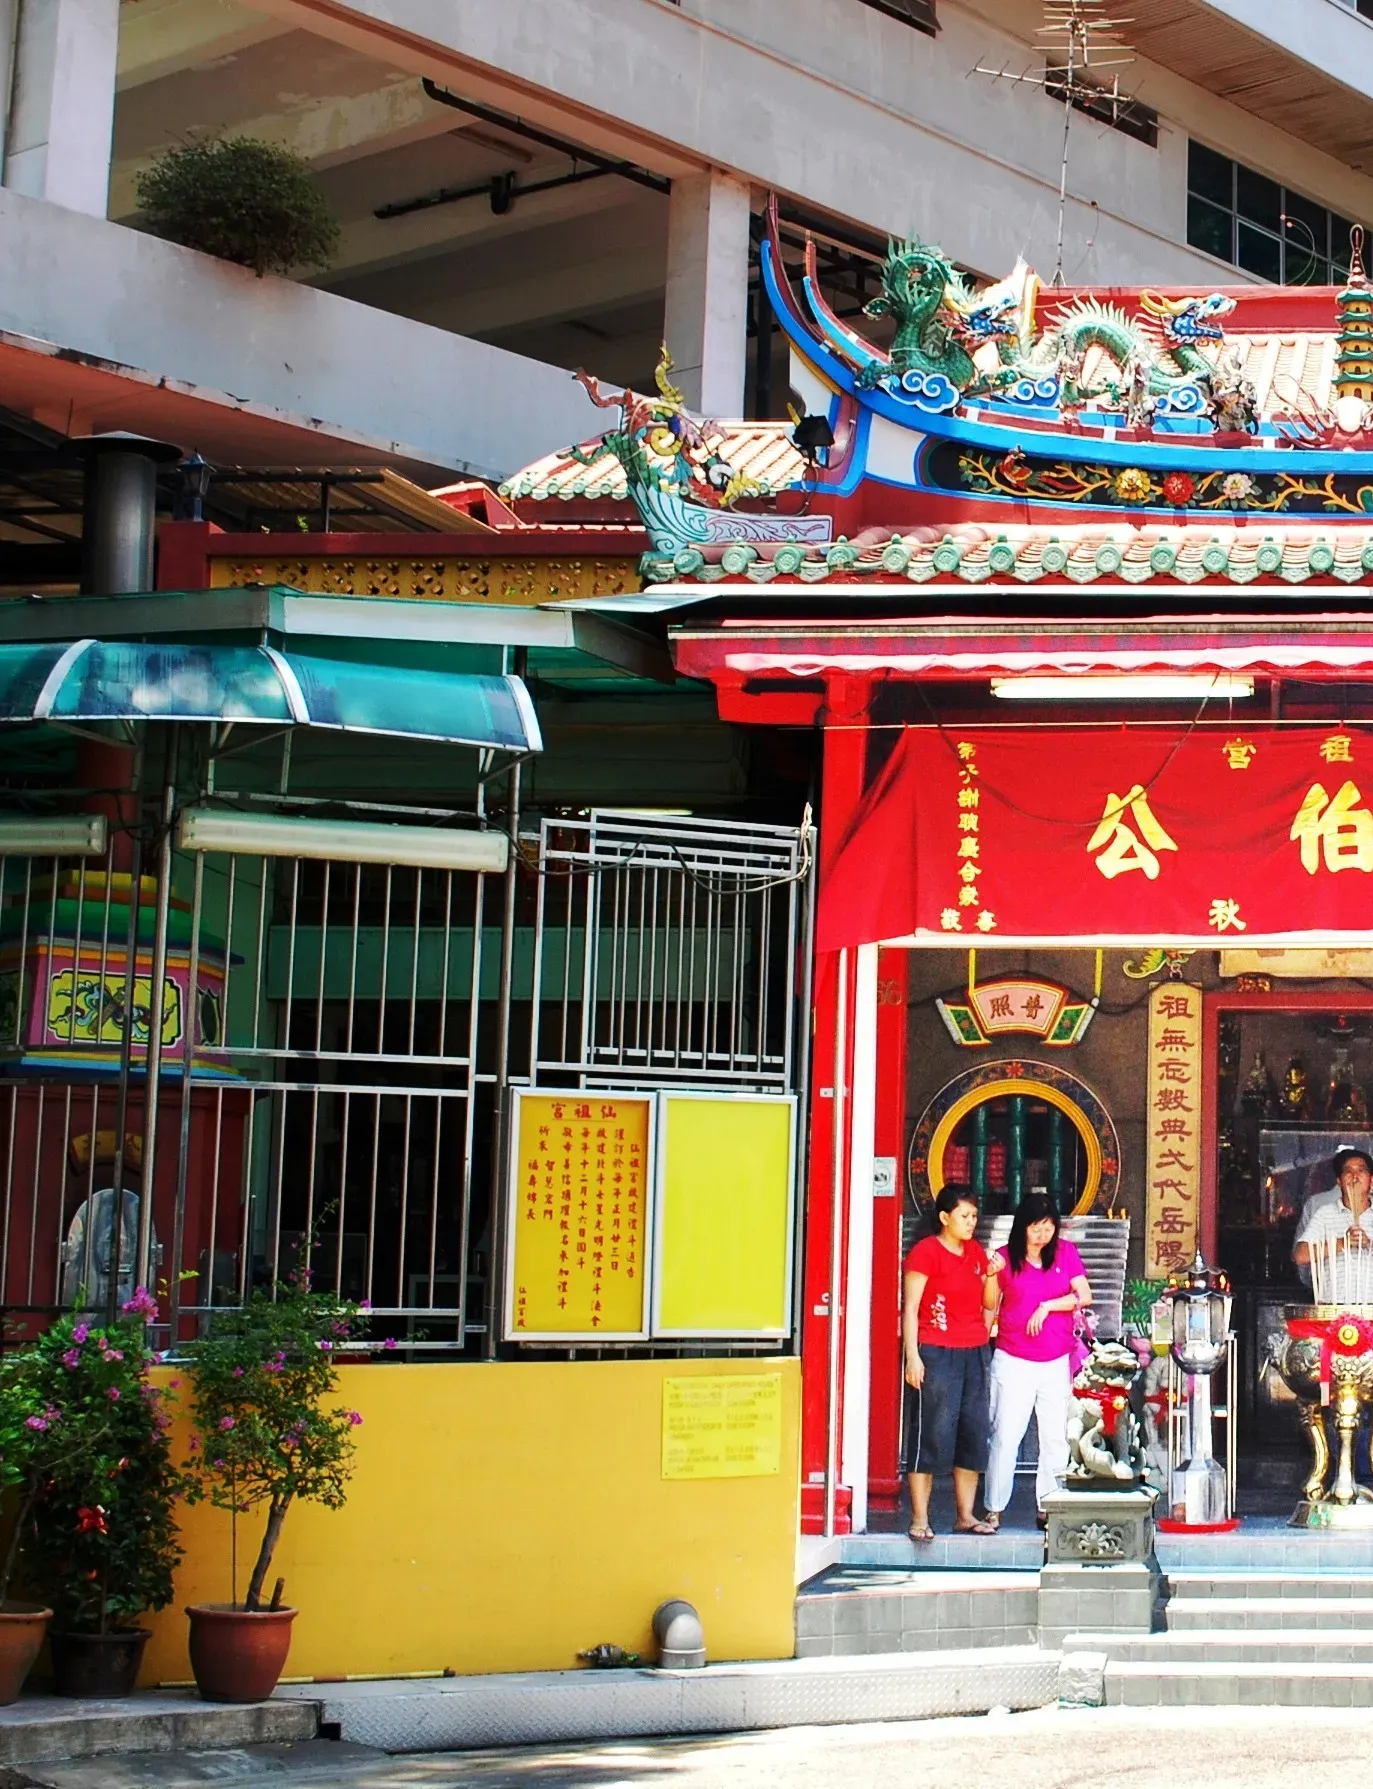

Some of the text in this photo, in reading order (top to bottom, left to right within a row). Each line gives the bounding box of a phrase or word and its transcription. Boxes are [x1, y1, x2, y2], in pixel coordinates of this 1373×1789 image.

[989, 994, 1045, 1019] 普照
[550, 1101, 618, 1119] 仙祖宮
